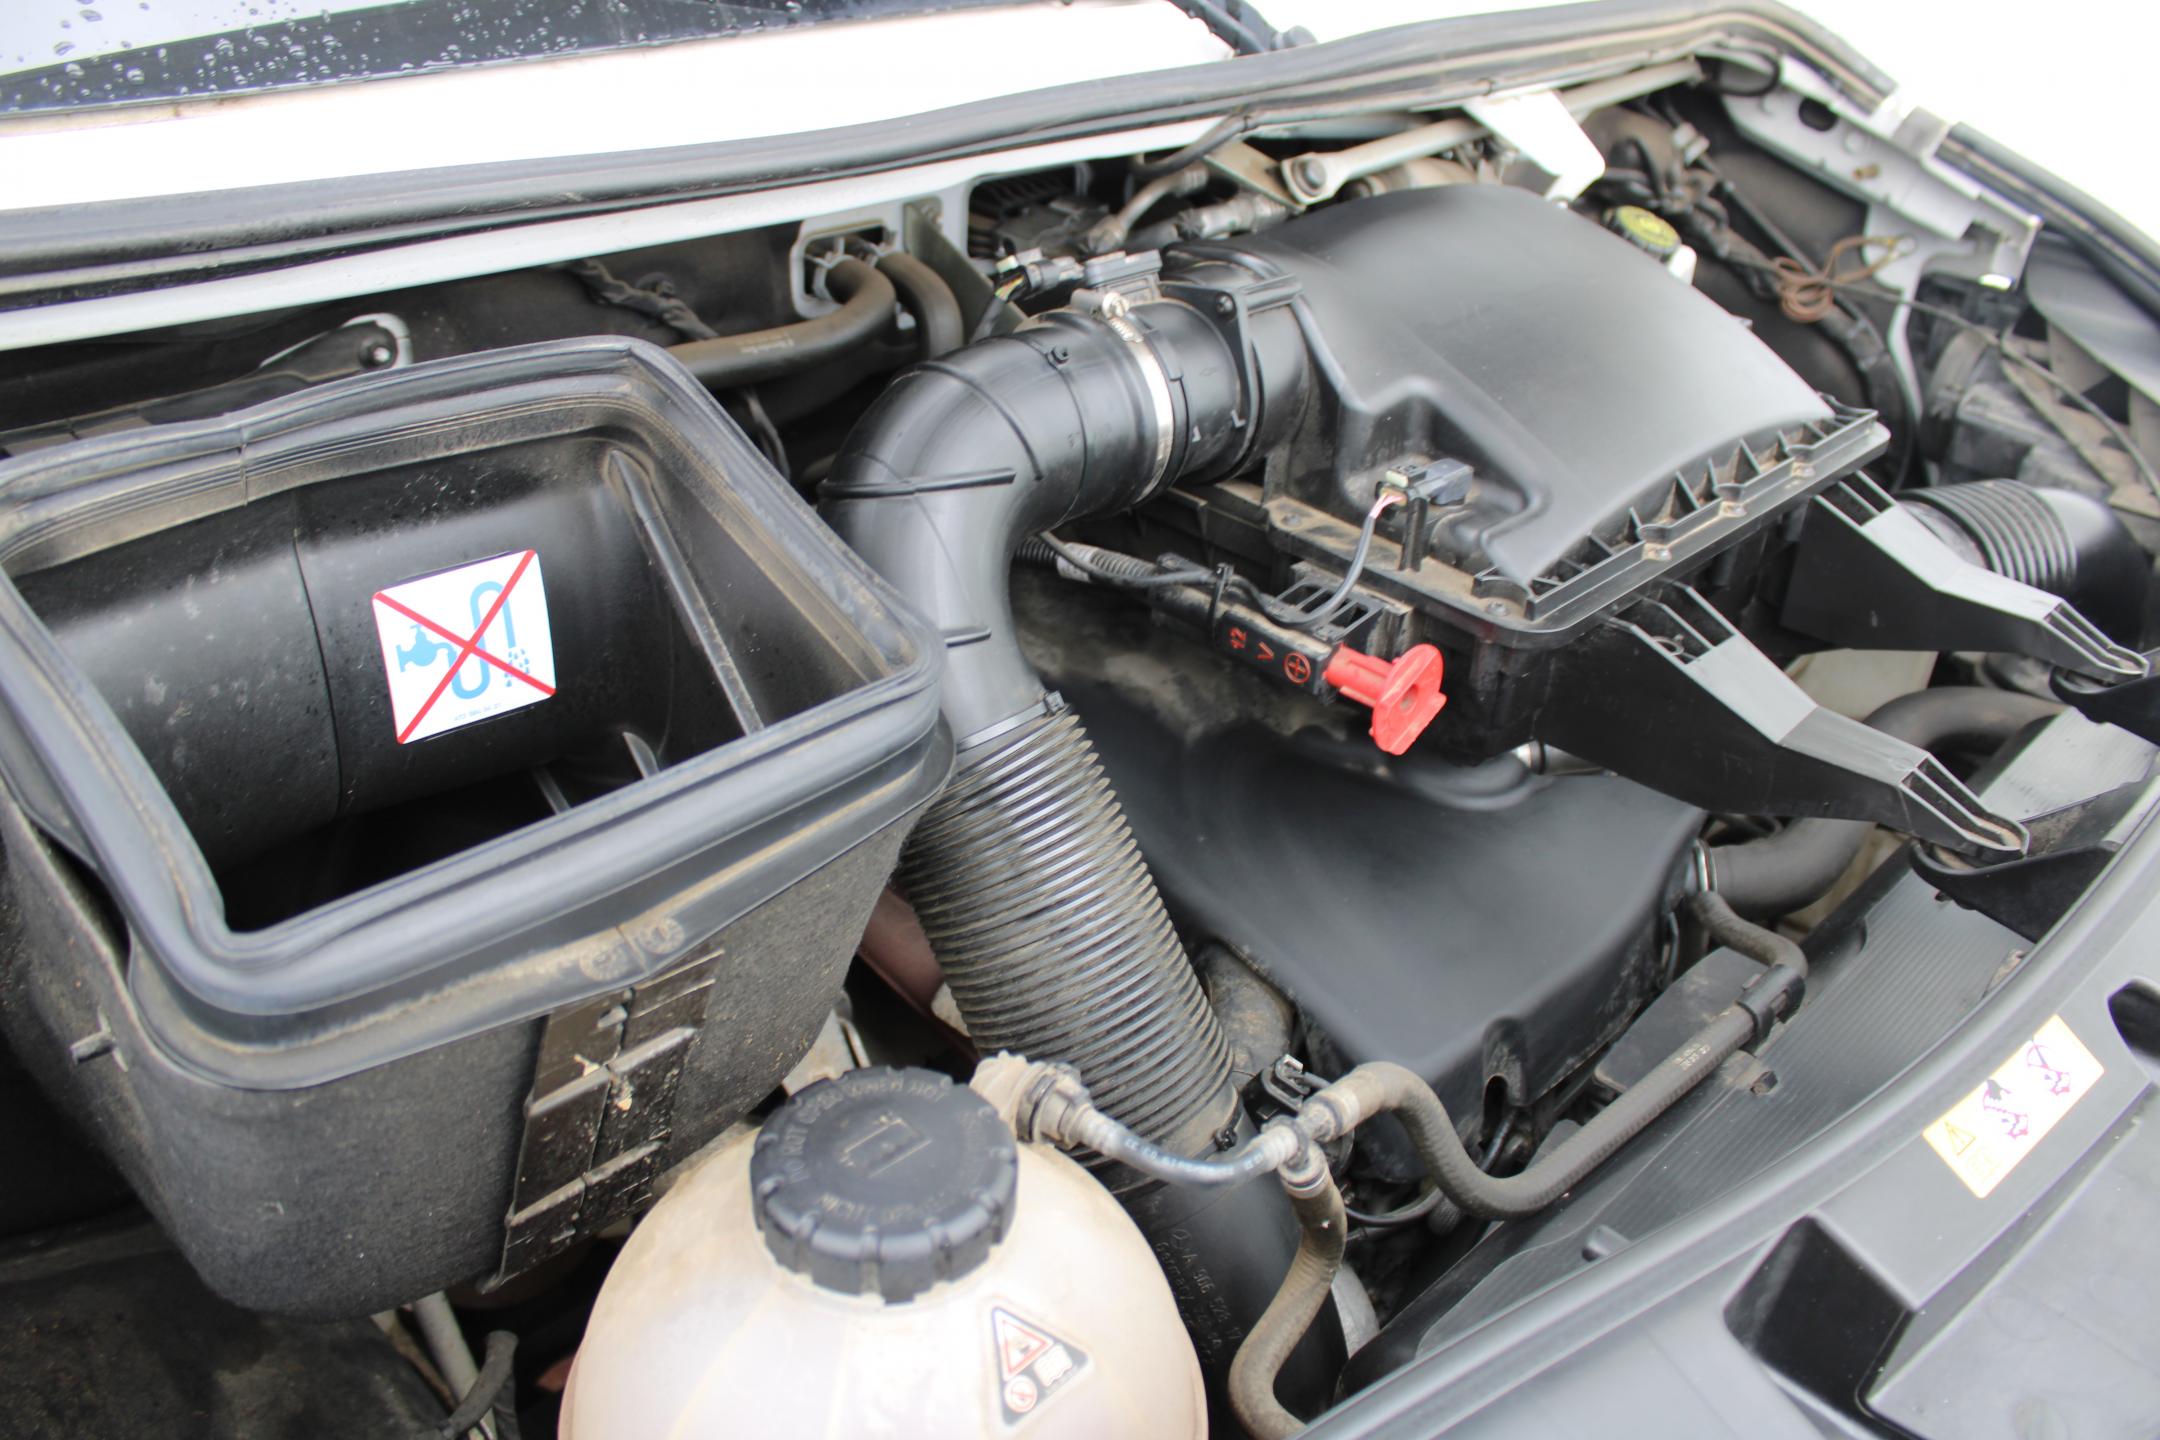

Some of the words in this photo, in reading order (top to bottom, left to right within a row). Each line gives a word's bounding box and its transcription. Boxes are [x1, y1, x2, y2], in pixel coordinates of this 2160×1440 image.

[1229, 627, 1247, 649] 12
[1256, 641, 1275, 661] V
[1155, 1241, 1196, 1300] Germany
